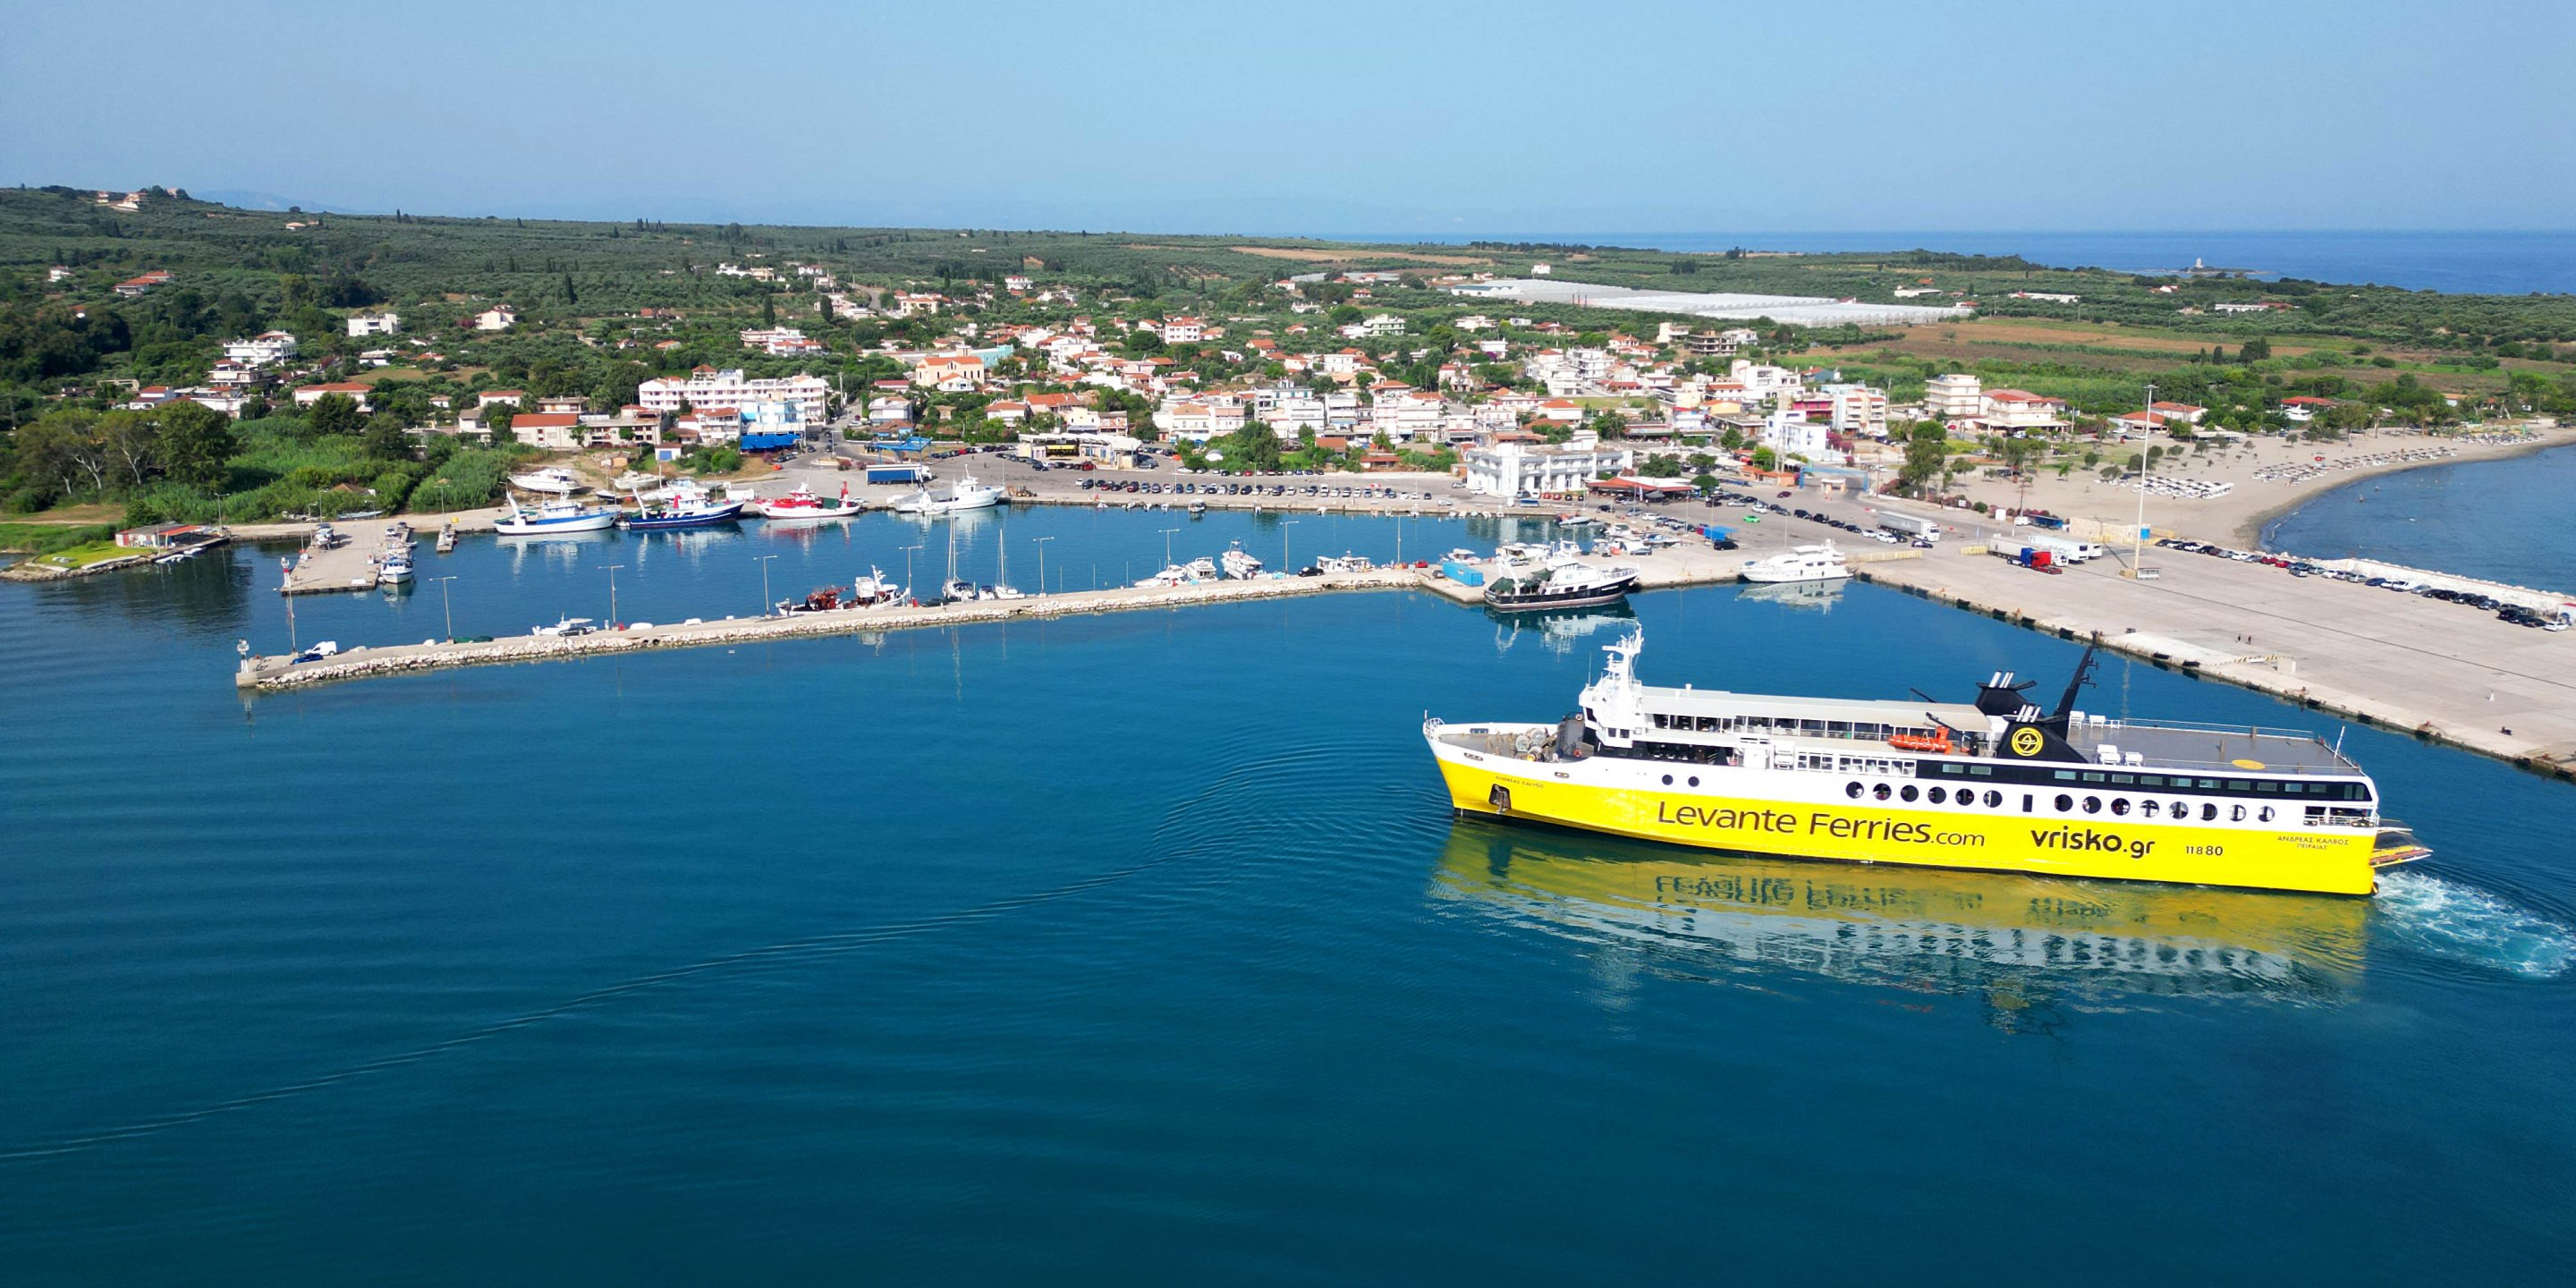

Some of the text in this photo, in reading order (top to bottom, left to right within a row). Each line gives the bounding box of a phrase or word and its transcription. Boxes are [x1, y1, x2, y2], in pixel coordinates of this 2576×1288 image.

[1658, 801, 1985, 846] Levante Ferries.com
[2030, 825, 2156, 859] vrisko.gr
[2277, 835, 2314, 843] ΑΝΔΡΕΑΣ
[2185, 845, 2224, 856] 11880
